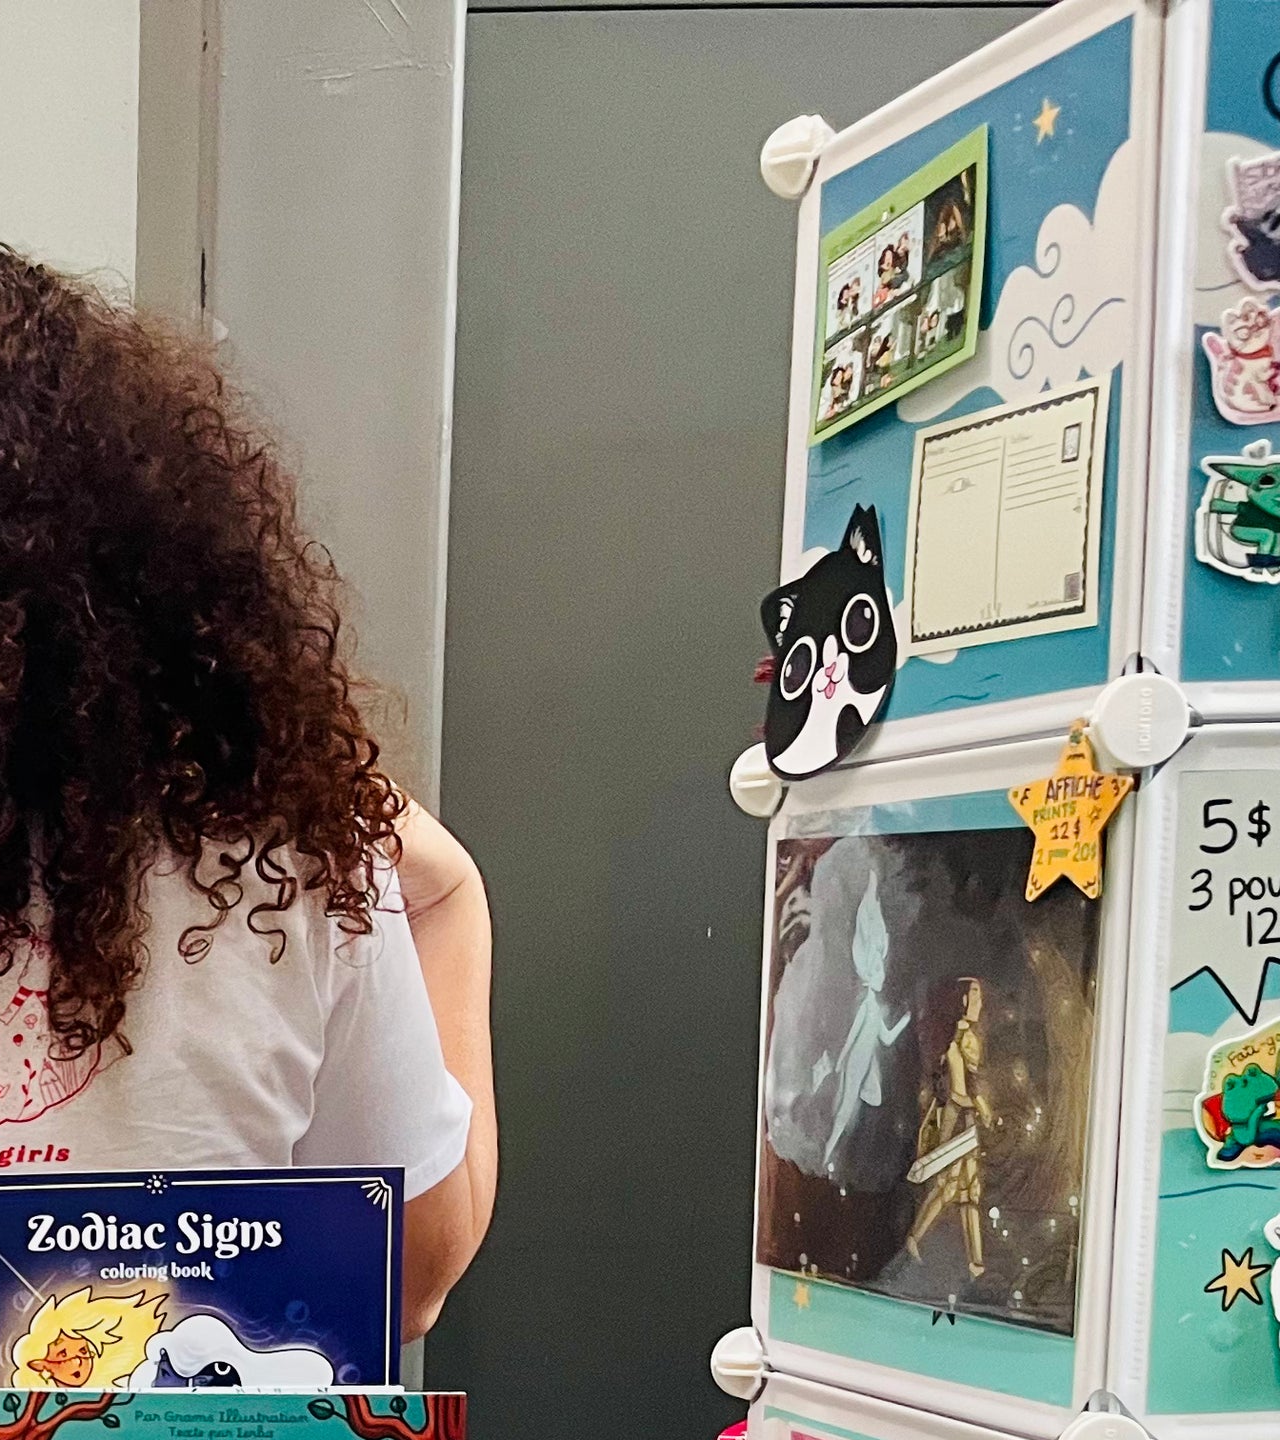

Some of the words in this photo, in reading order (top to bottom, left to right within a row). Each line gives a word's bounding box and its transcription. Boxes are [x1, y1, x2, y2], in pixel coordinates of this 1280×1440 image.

[1045, 775, 1105, 802] AFFICHE
[1188, 869, 1212, 911] 3
[27, 1214, 165, 1258] Zodiac
[175, 1213, 282, 1261] Signs
[100, 1263, 164, 1285] coloring
[171, 1261, 212, 1280] book
